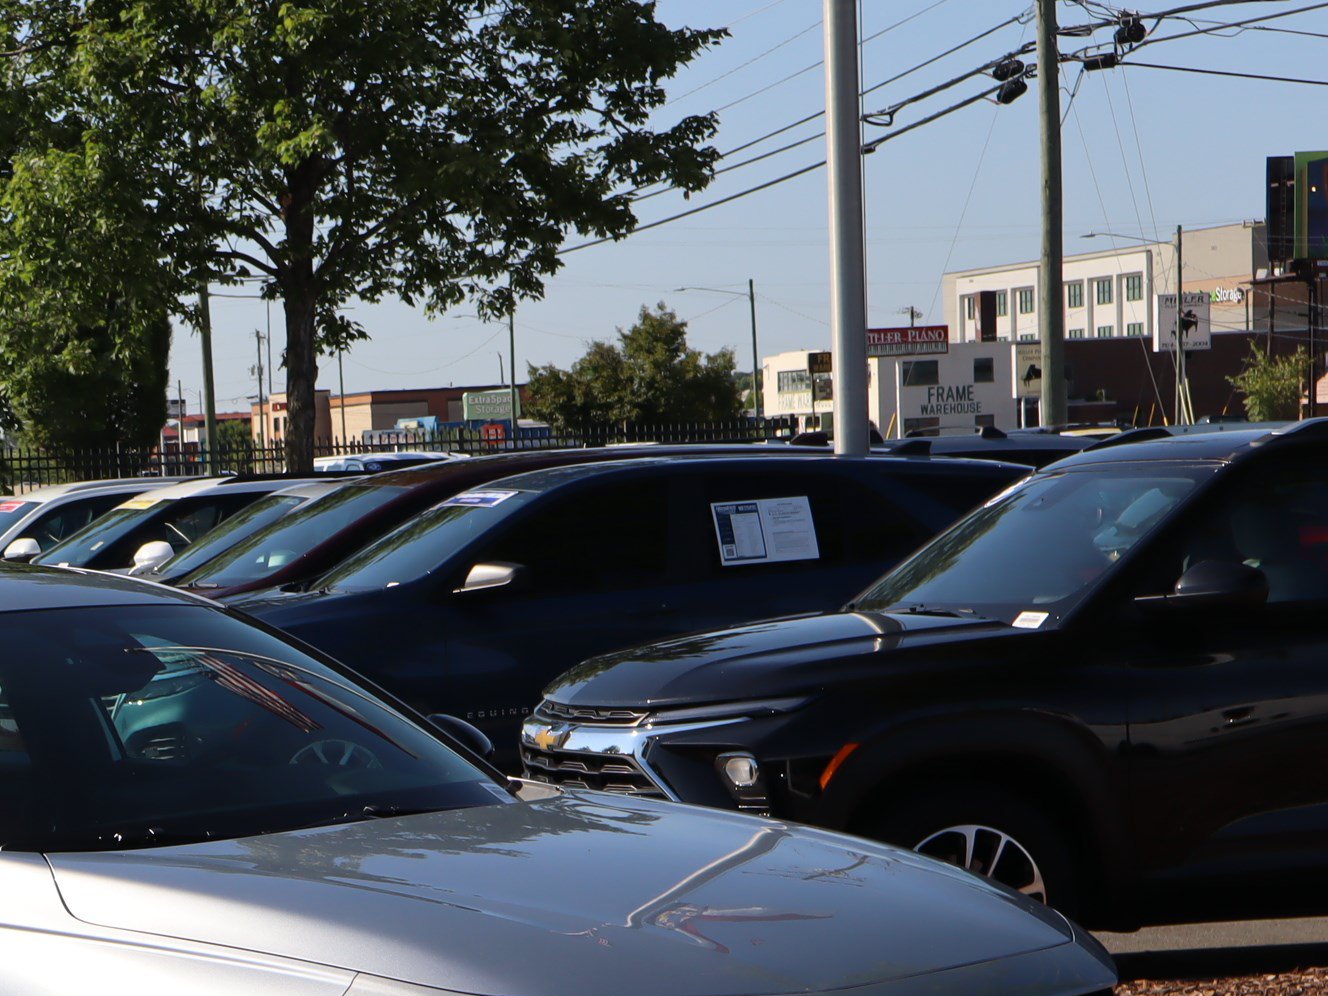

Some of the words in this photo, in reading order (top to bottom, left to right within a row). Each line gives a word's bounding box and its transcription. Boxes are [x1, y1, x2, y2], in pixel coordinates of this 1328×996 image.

[1164, 295, 1204, 305] MILER
[927, 385, 974, 403] FRAME
[920, 402, 982, 415] WAREHOUSE
[466, 707, 530, 719] EQUINO
